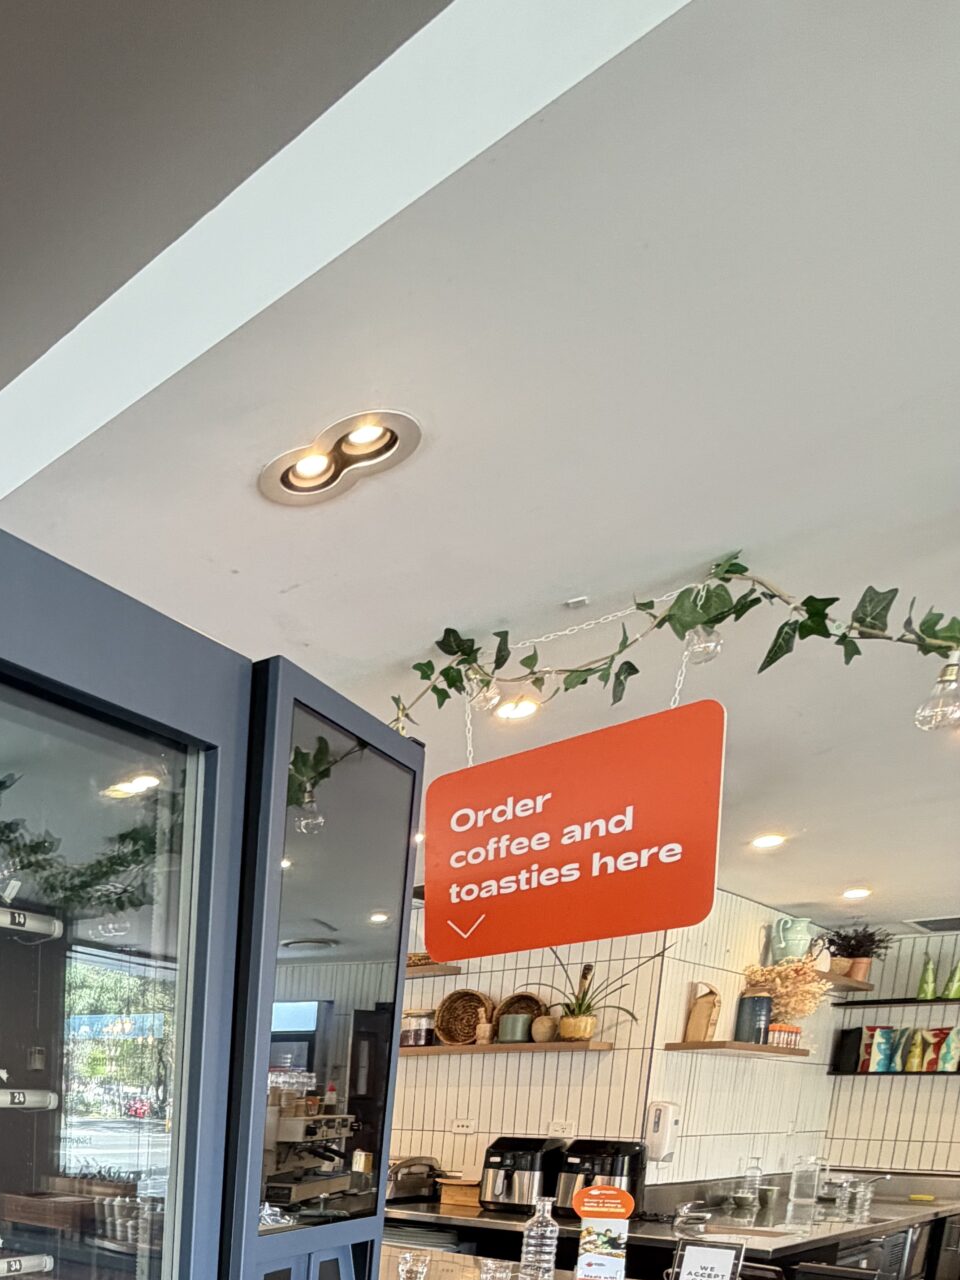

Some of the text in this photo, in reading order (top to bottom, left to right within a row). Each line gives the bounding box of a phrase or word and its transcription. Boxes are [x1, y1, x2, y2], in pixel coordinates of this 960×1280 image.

[450, 792, 552, 832] Order
[449, 805, 634, 868] coffee and
[449, 842, 683, 903] toasties here
[14, 913, 25, 924] 14
[14, 1093, 25, 1103] 24
[10, 1261, 21, 1271] 34
[686, 1271, 726, 1280] ACCEPT
